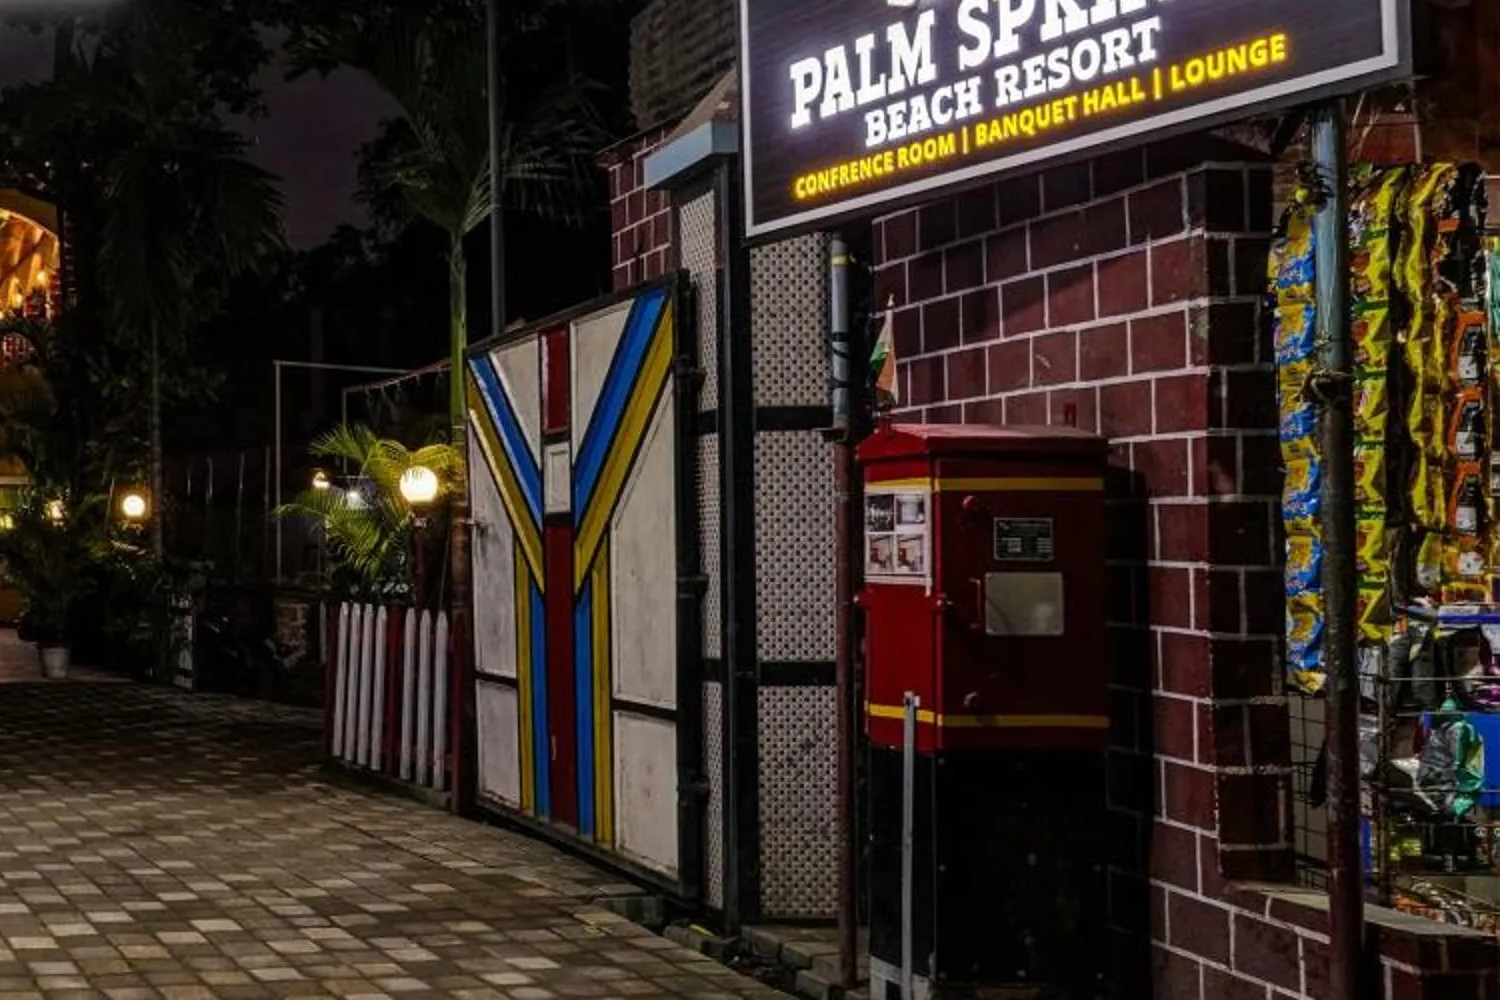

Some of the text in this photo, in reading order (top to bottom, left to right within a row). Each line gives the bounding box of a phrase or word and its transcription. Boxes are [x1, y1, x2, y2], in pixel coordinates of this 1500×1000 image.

[789, 9, 937, 129] PALM
[795, 151, 895, 199] CONFRENCE
[897, 133, 957, 169] ROOM
[975, 96, 1078, 147] BANQUET
[1083, 76, 1146, 115] HALL
[1170, 34, 1287, 89] LOUNGE
[864, 16, 1161, 147] BEACH RESORT
